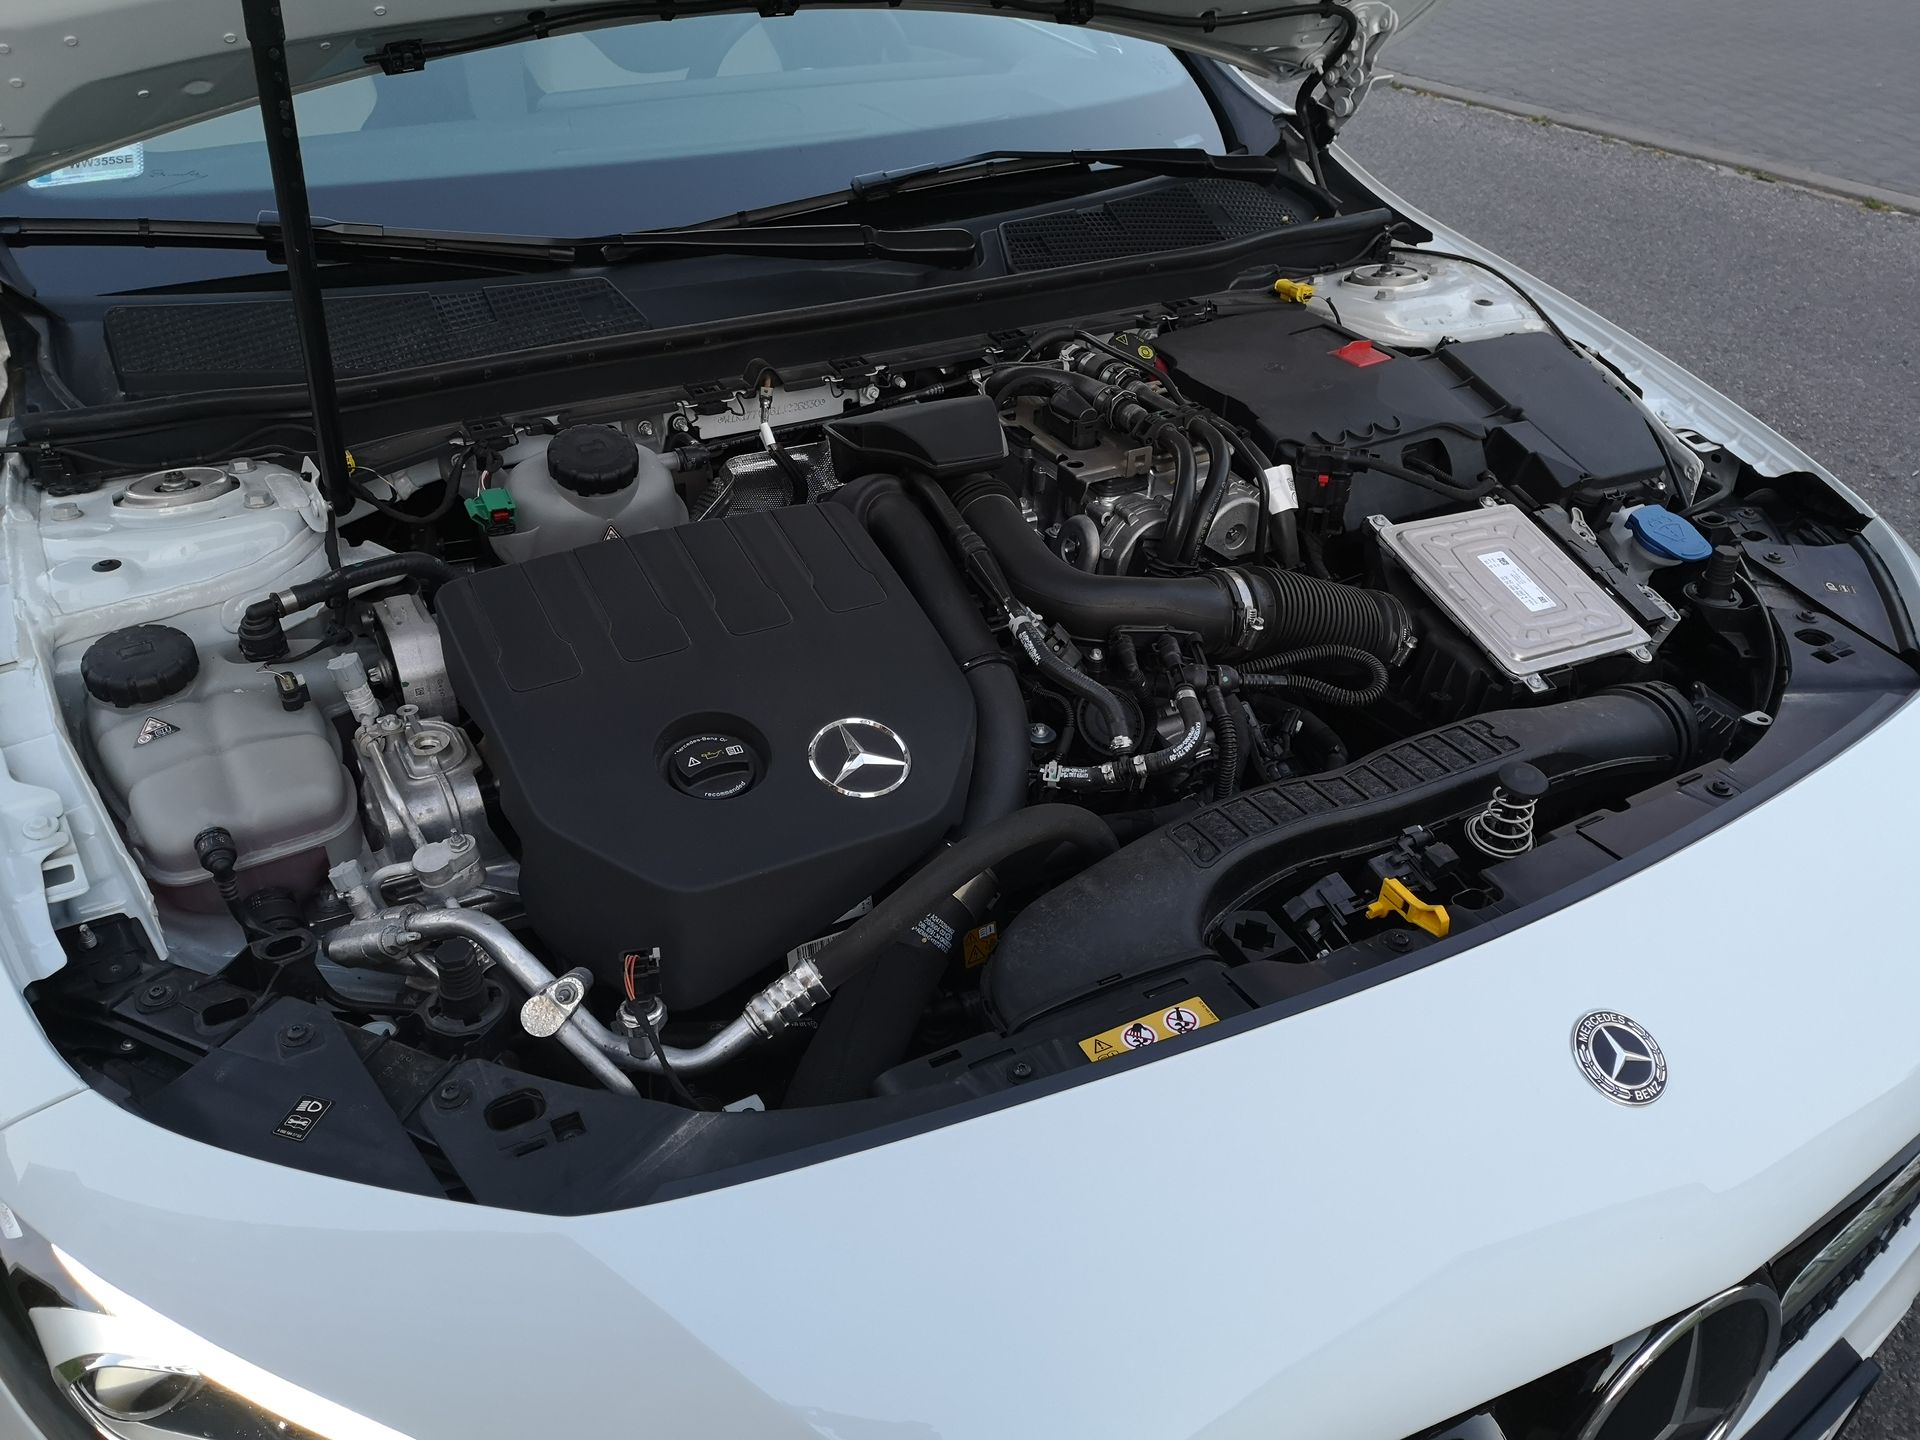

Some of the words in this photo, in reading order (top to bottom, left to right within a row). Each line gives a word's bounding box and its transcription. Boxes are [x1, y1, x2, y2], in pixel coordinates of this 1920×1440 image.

[704, 780, 746, 798] recommended
[1577, 1012, 1626, 1043] MERCEDES
[1634, 1080, 1662, 1101] BENZ
